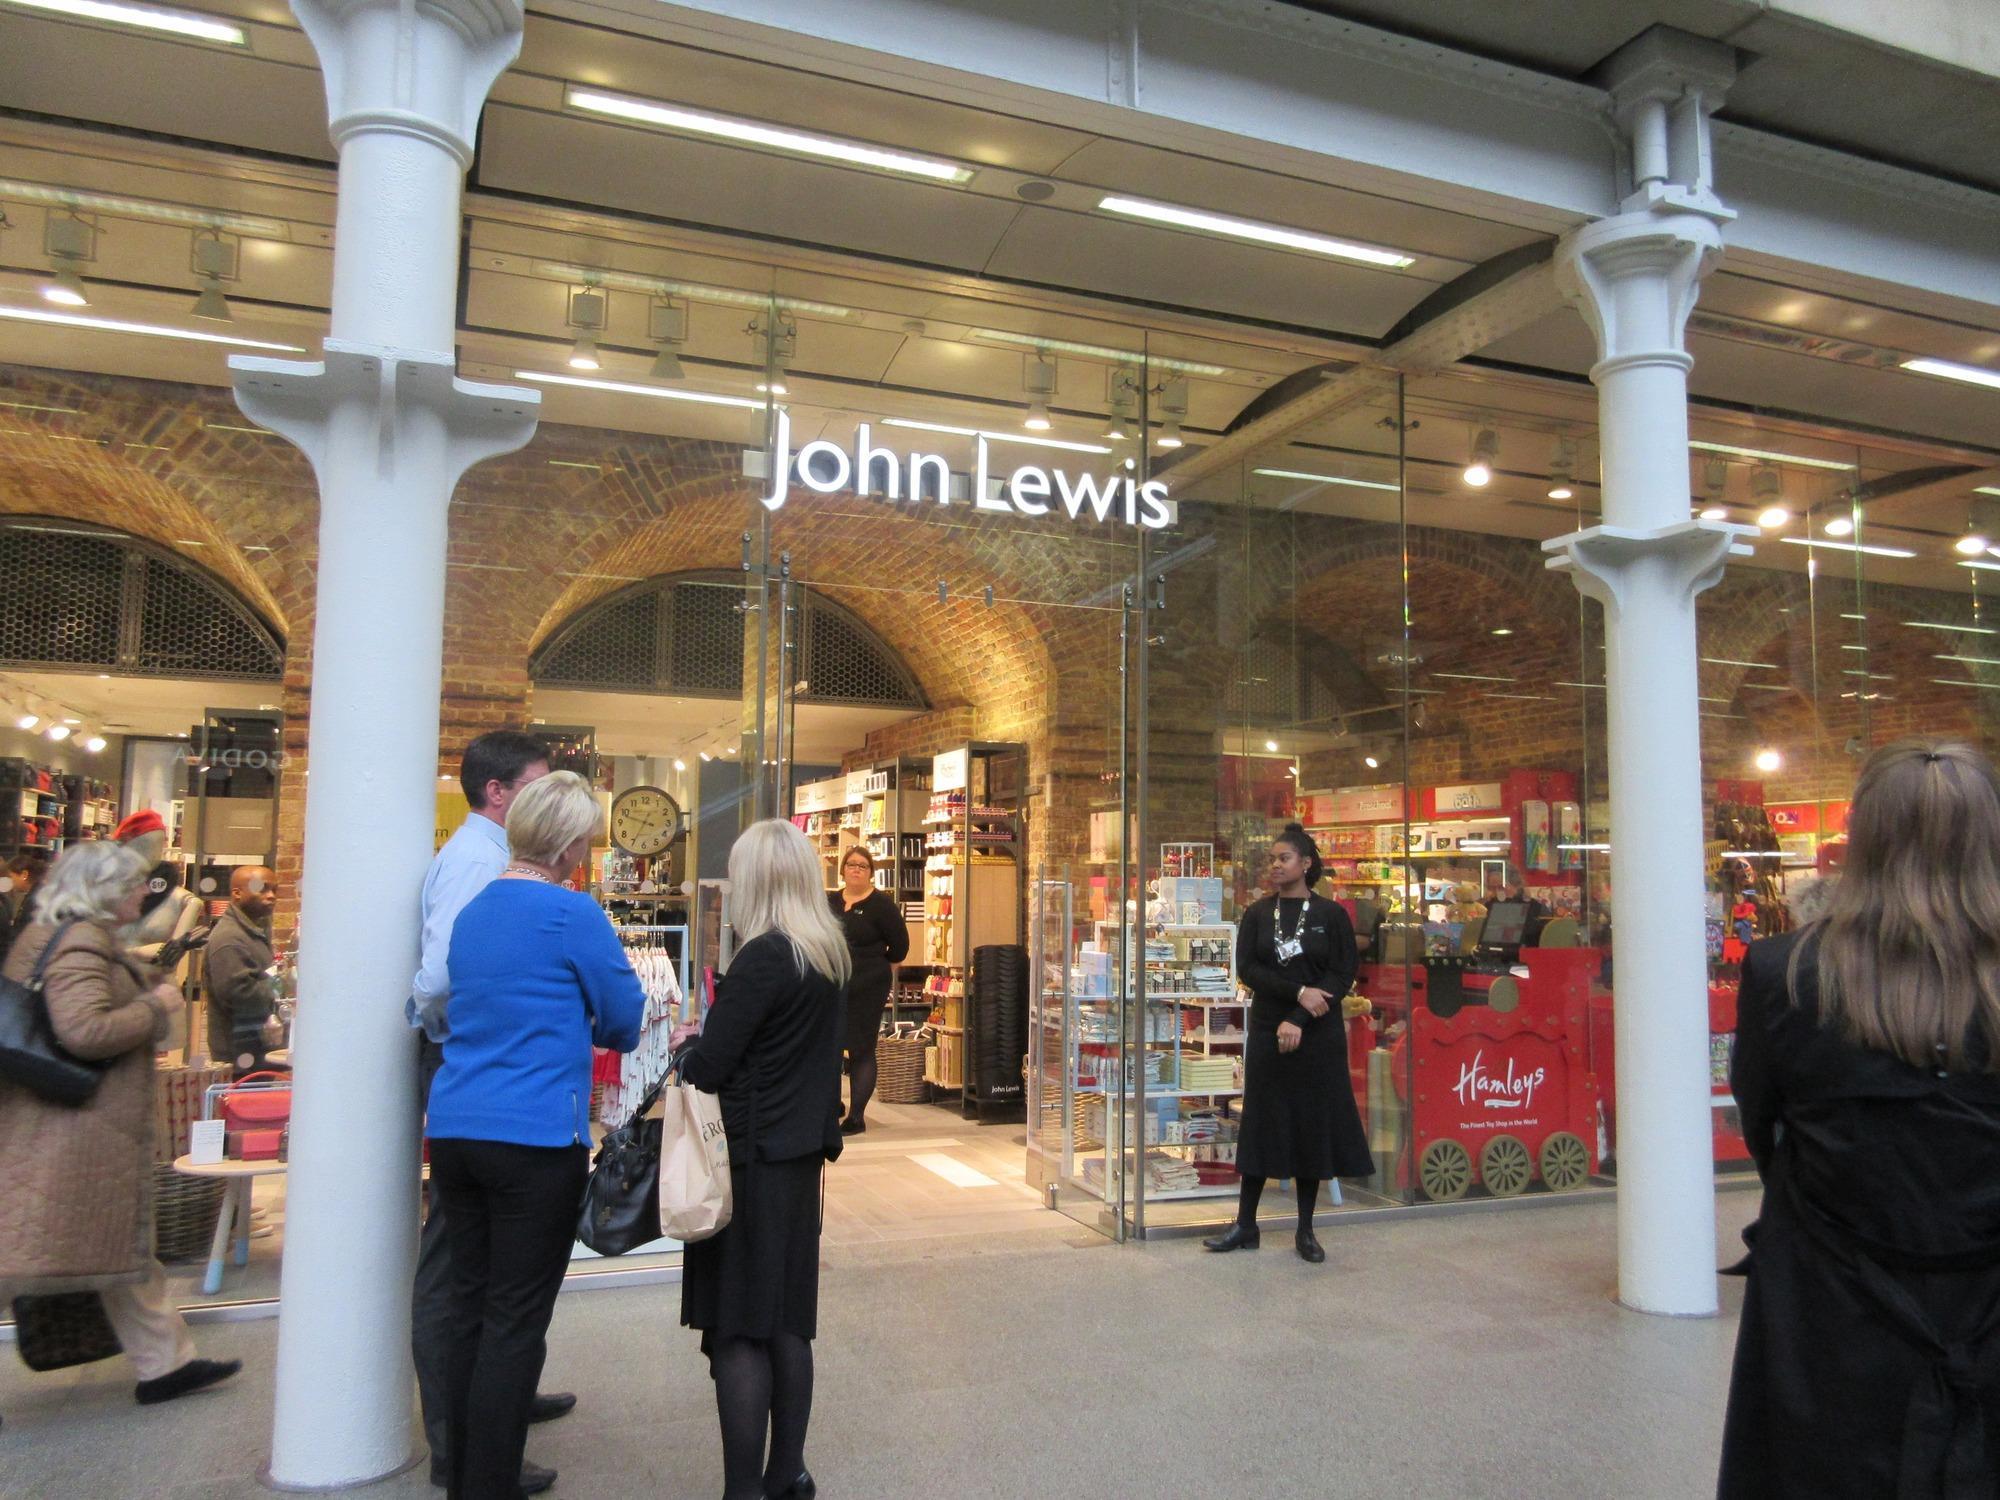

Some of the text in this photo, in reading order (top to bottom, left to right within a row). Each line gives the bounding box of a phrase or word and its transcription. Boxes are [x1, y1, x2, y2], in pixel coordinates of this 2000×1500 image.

[759, 408, 1173, 530] John Lewis
[622, 808, 630, 817] 10
[662, 808, 669, 816] 2
[617, 818, 623, 827] 9
[665, 819, 672, 827] 3
[621, 830, 627, 838] 8
[630, 839, 636, 847] 7
[653, 838, 659, 846] 5
[1452, 1049, 1544, 1109] Hamleys
[991, 1085, 1005, 1093] John
[1486, 1121, 1495, 1129] Toy
[1495, 1120, 1508, 1128] Shop
[1523, 1117, 1538, 1125] World
